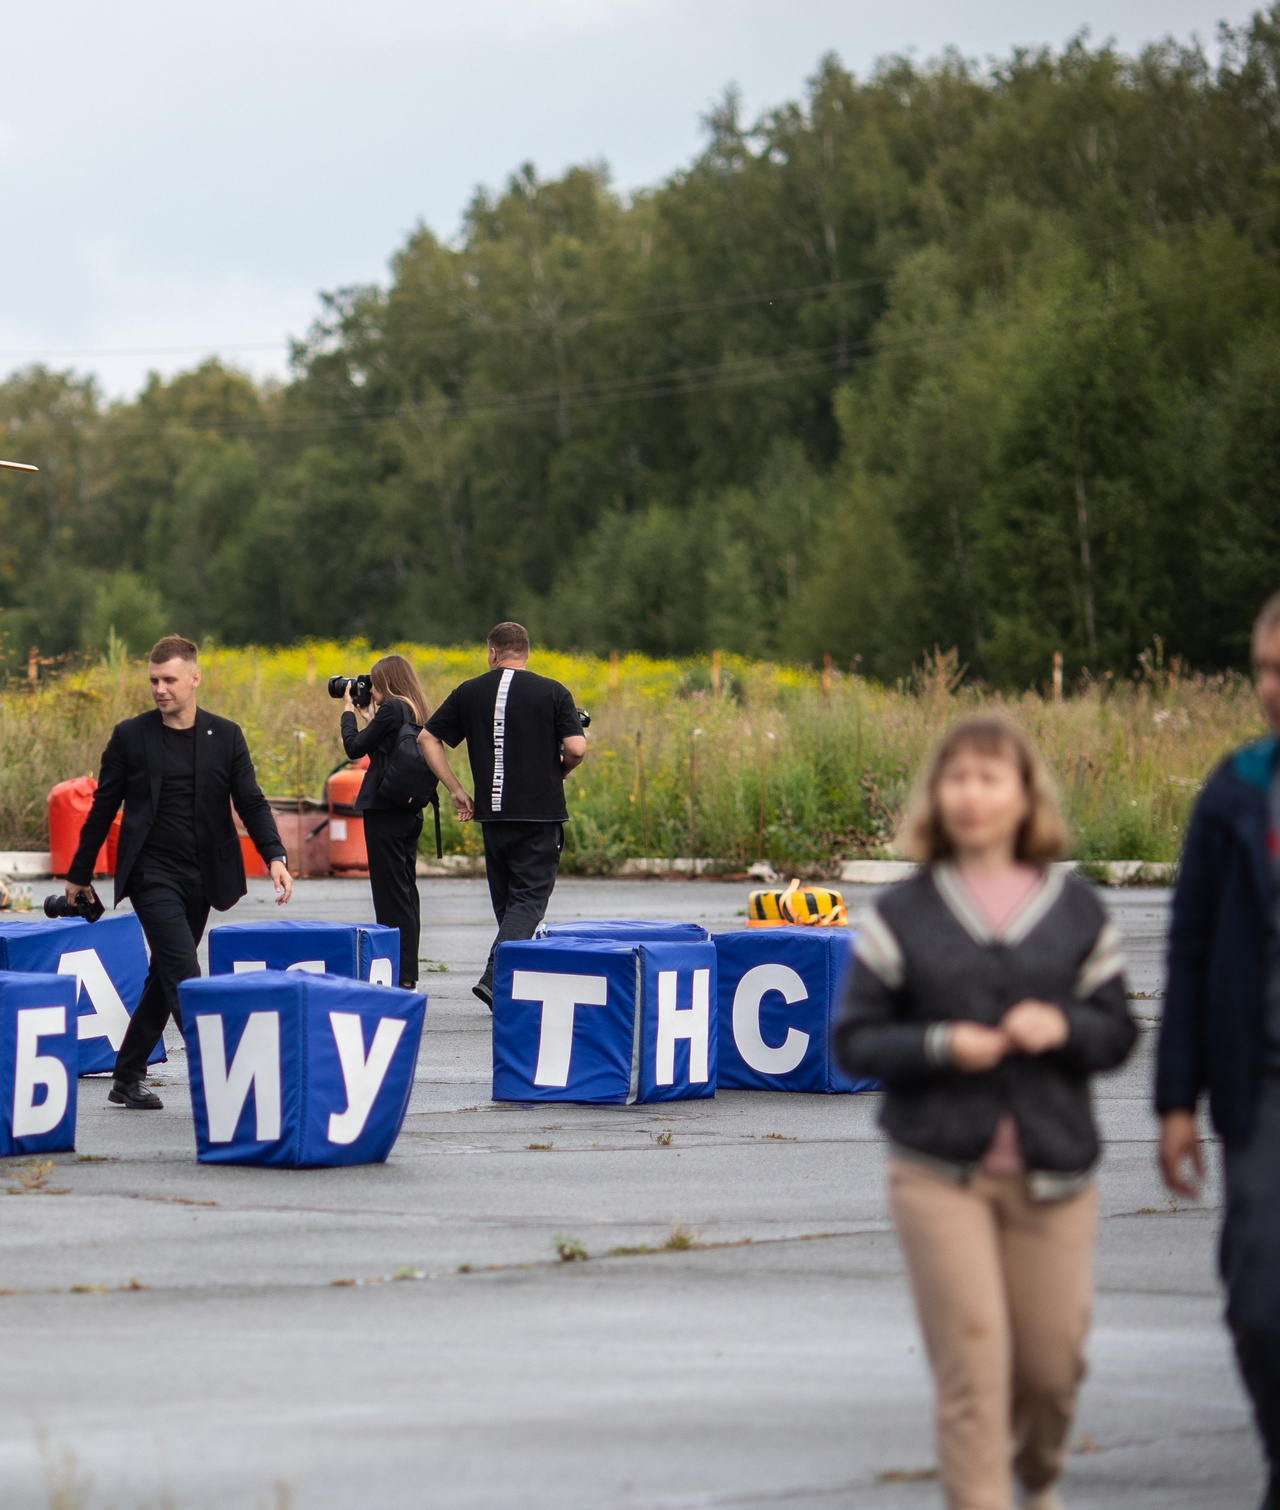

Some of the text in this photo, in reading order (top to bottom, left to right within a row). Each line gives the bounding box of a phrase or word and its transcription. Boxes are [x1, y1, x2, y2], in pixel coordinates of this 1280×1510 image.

[57, 948, 132, 1052] А
[511, 970, 608, 1087] Т
[732, 963, 810, 1075] С
[12, 1005, 68, 1138] Б
[195, 1011, 281, 1143] И
